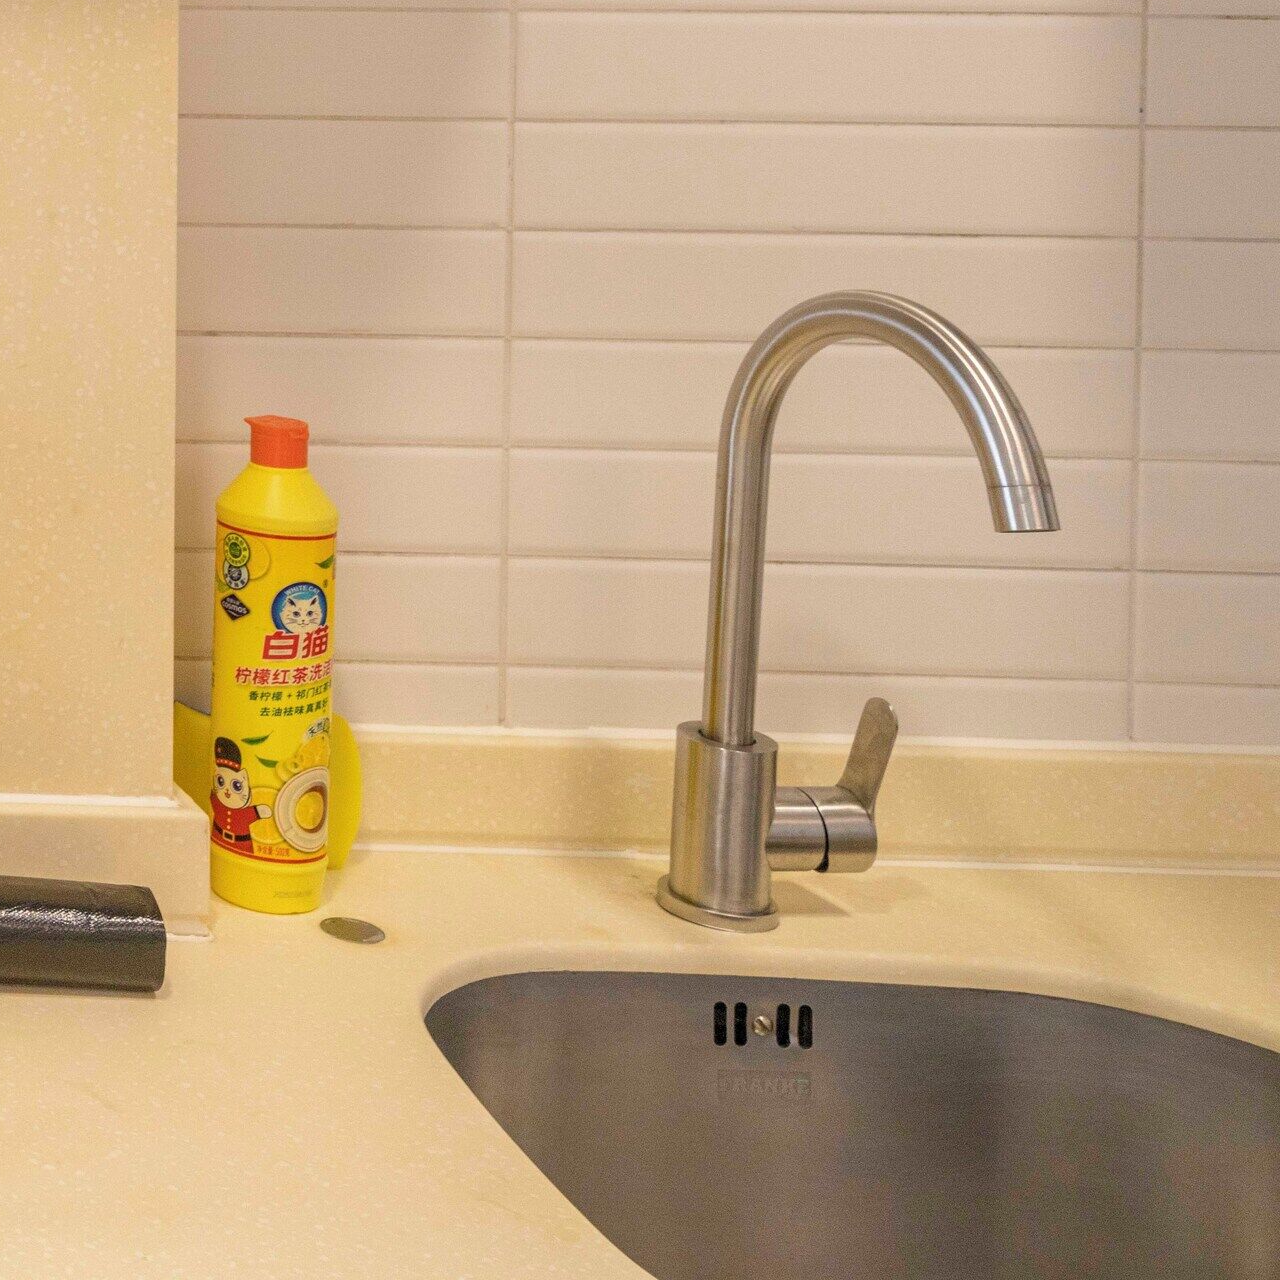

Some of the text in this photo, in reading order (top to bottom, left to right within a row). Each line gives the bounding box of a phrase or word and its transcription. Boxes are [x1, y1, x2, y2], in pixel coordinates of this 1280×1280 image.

[284, 585, 321, 596] WHITE CAT
[262, 625, 329, 660] 白猫
